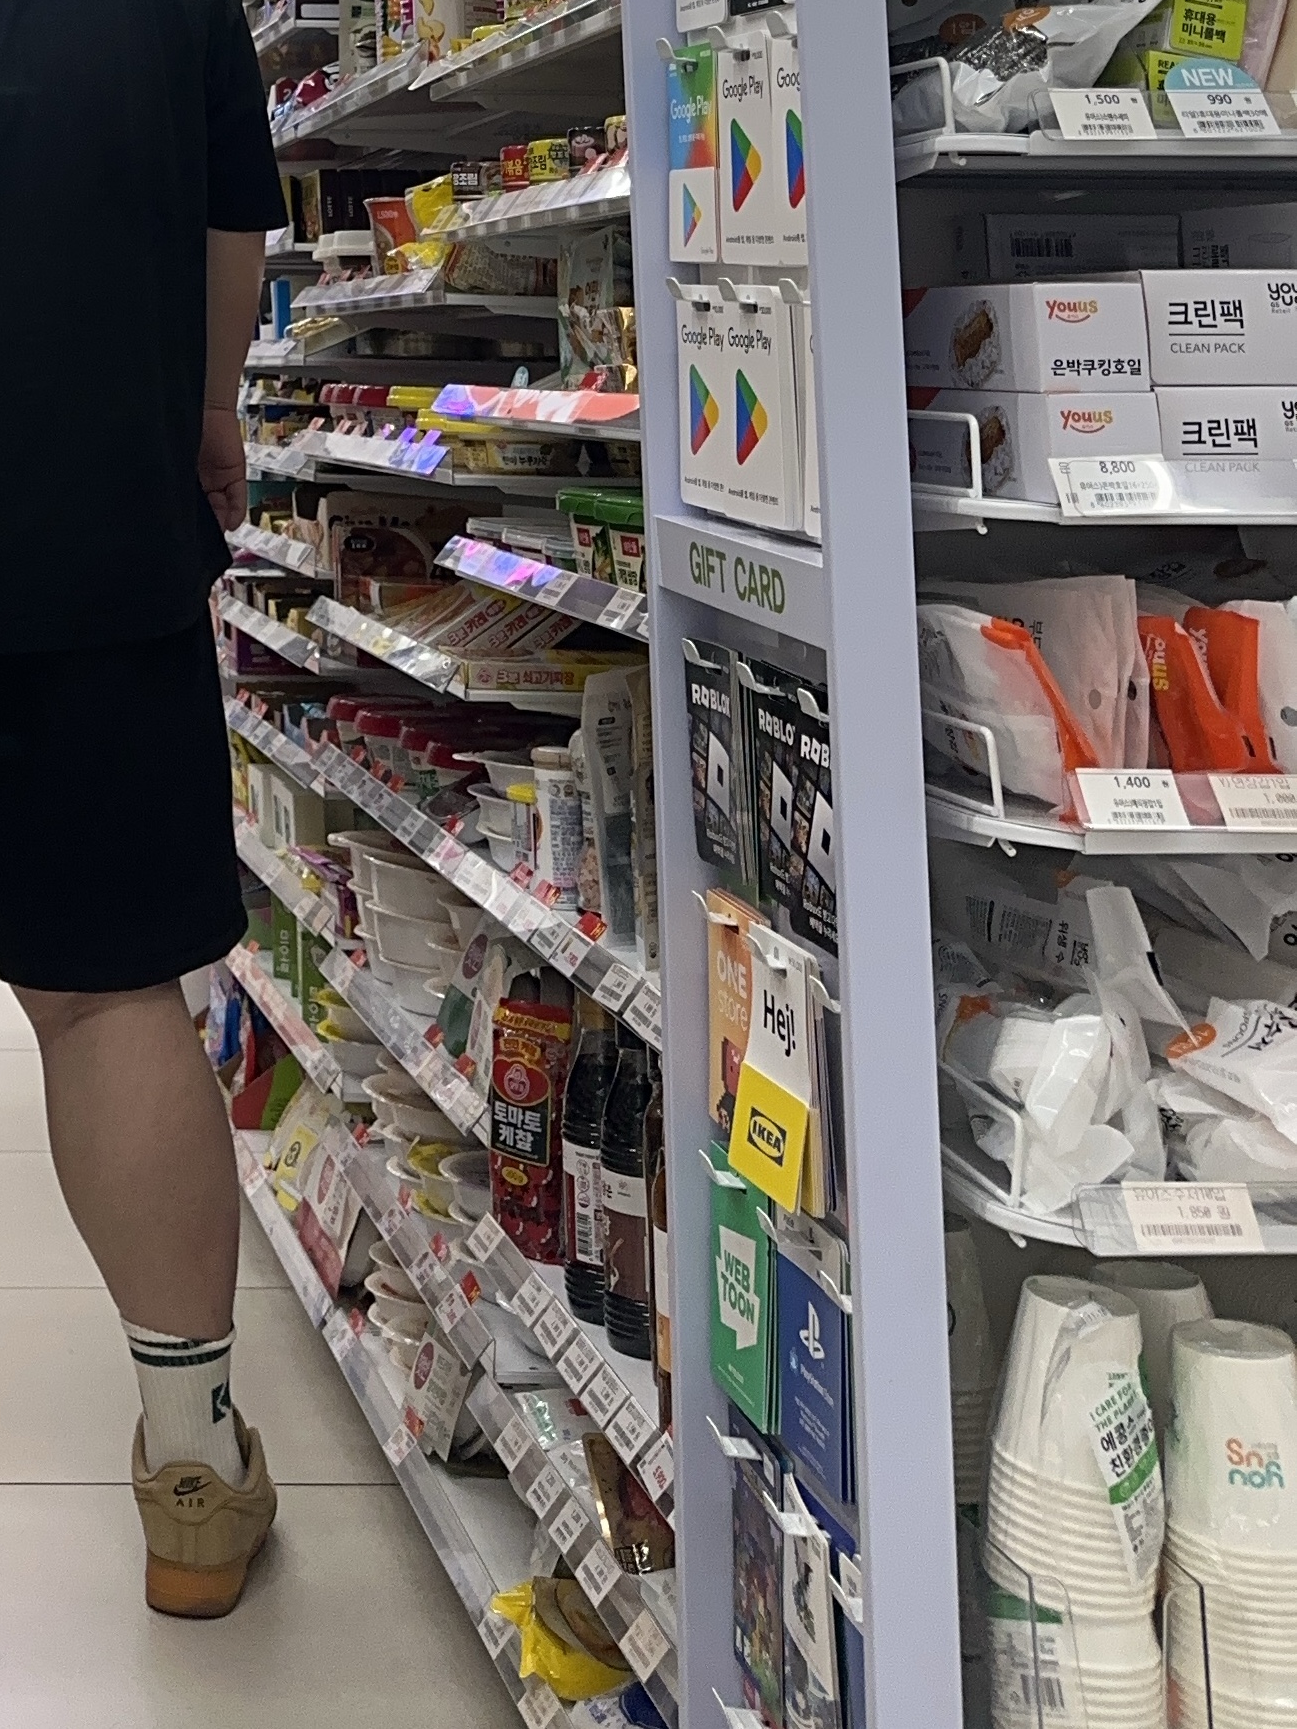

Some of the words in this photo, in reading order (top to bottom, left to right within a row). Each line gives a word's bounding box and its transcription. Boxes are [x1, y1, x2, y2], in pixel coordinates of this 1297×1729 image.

[1184, 8, 1217, 26] 휴대용
[1181, 22, 1226, 43] 미니롤백
[1158, 59, 1175, 69] REA
[1181, 68, 1234, 87] NEW
[722, 78, 748, 103] Google
[748, 75, 764, 100] Play
[1085, 93, 1120, 106] 1,500
[1207, 93, 1232, 105] 990
[670, 98, 696, 124] Google
[696, 94, 712, 120] Play
[1167, 298, 1246, 330] 크린팩
[681, 324, 707, 350] Google
[708, 326, 725, 352] Play
[727, 327, 755, 354] Google
[756, 330, 772, 356] Play
[1170, 341, 1212, 354] CLEAN
[1214, 341, 1247, 354] PACK
[1050, 358, 1142, 376] 은박쿠킹호일
[1181, 418, 1259, 448] 크린팩
[1099, 460, 1136, 476] 8,800
[1184, 460, 1226, 473] CLEAN
[1228, 460, 1261, 473] PACK
[689, 540, 727, 595] GIFT
[733, 555, 787, 616] CARD
[691, 683, 731, 719] ROBLOX
[758, 707, 796, 747] ROBLO
[801, 733, 831, 769] ROB
[1114, 776, 1151, 789] 1,400
[716, 948, 749, 1000] ONE
[716, 987, 749, 1033] store
[763, 988, 797, 1058] Hej!
[493, 1100, 543, 1134] 토마토
[752, 1117, 785, 1154] IKEA
[723, 1249, 751, 1294] WEB
[720, 1270, 756, 1325] TOON
[1095, 1395, 1118, 1417] CARE
[176, 1497, 205, 1508] AIR
